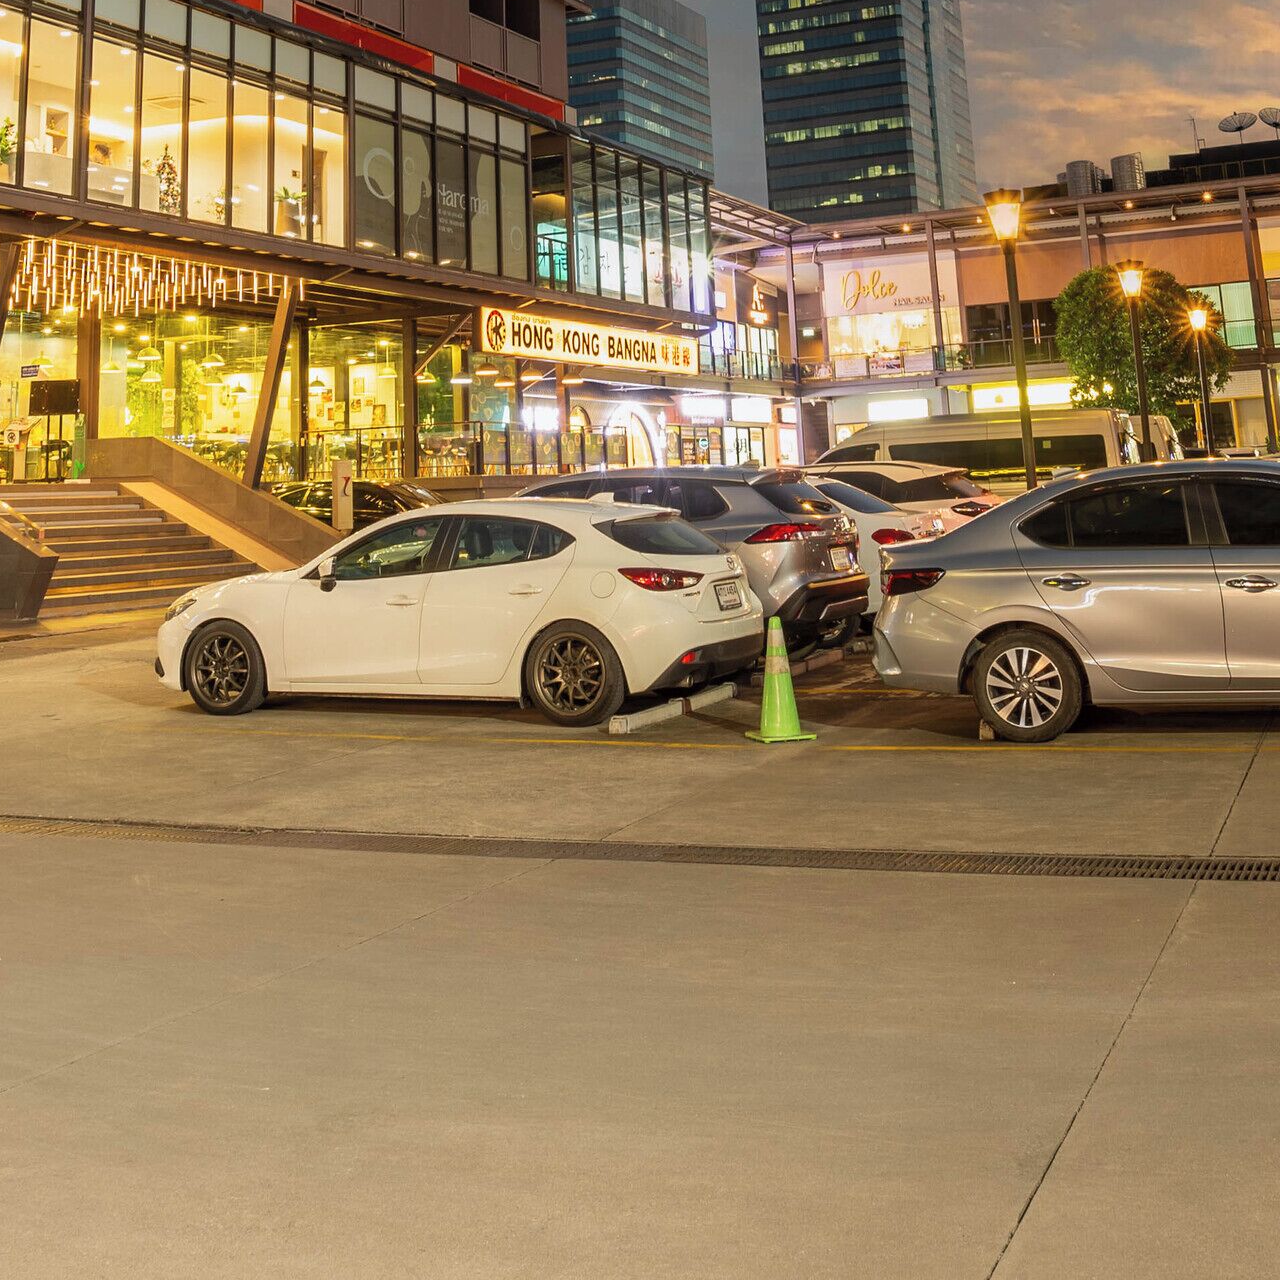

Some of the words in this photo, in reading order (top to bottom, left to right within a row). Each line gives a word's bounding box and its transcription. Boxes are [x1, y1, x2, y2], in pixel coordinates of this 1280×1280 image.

[841, 269, 898, 311] Dolce
[916, 294, 946, 306] SALN
[511, 322, 554, 352] HONG
[562, 329, 600, 357] KONG
[608, 336, 657, 364] BANGNA
